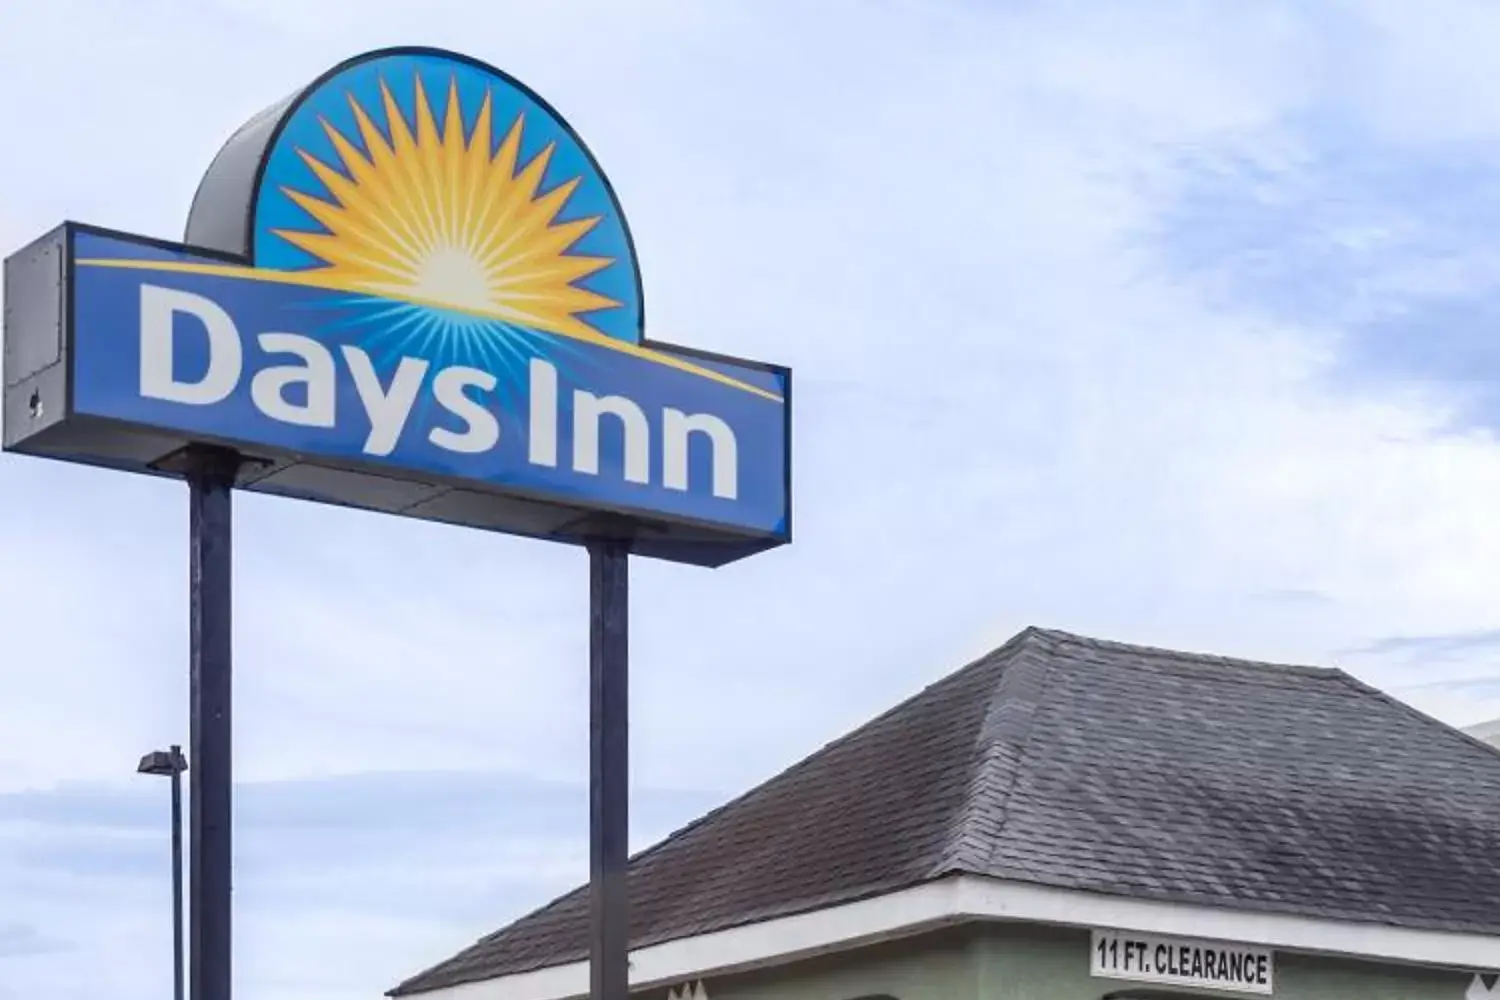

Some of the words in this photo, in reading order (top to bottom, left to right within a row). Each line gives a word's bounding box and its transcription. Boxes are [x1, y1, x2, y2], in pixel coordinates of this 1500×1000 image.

[140, 284, 500, 455] Days
[529, 358, 738, 500] Inn
[1098, 938, 1117, 968] 11
[1124, 941, 1150, 972] FT.
[1155, 944, 1267, 984] CLEARANCE
